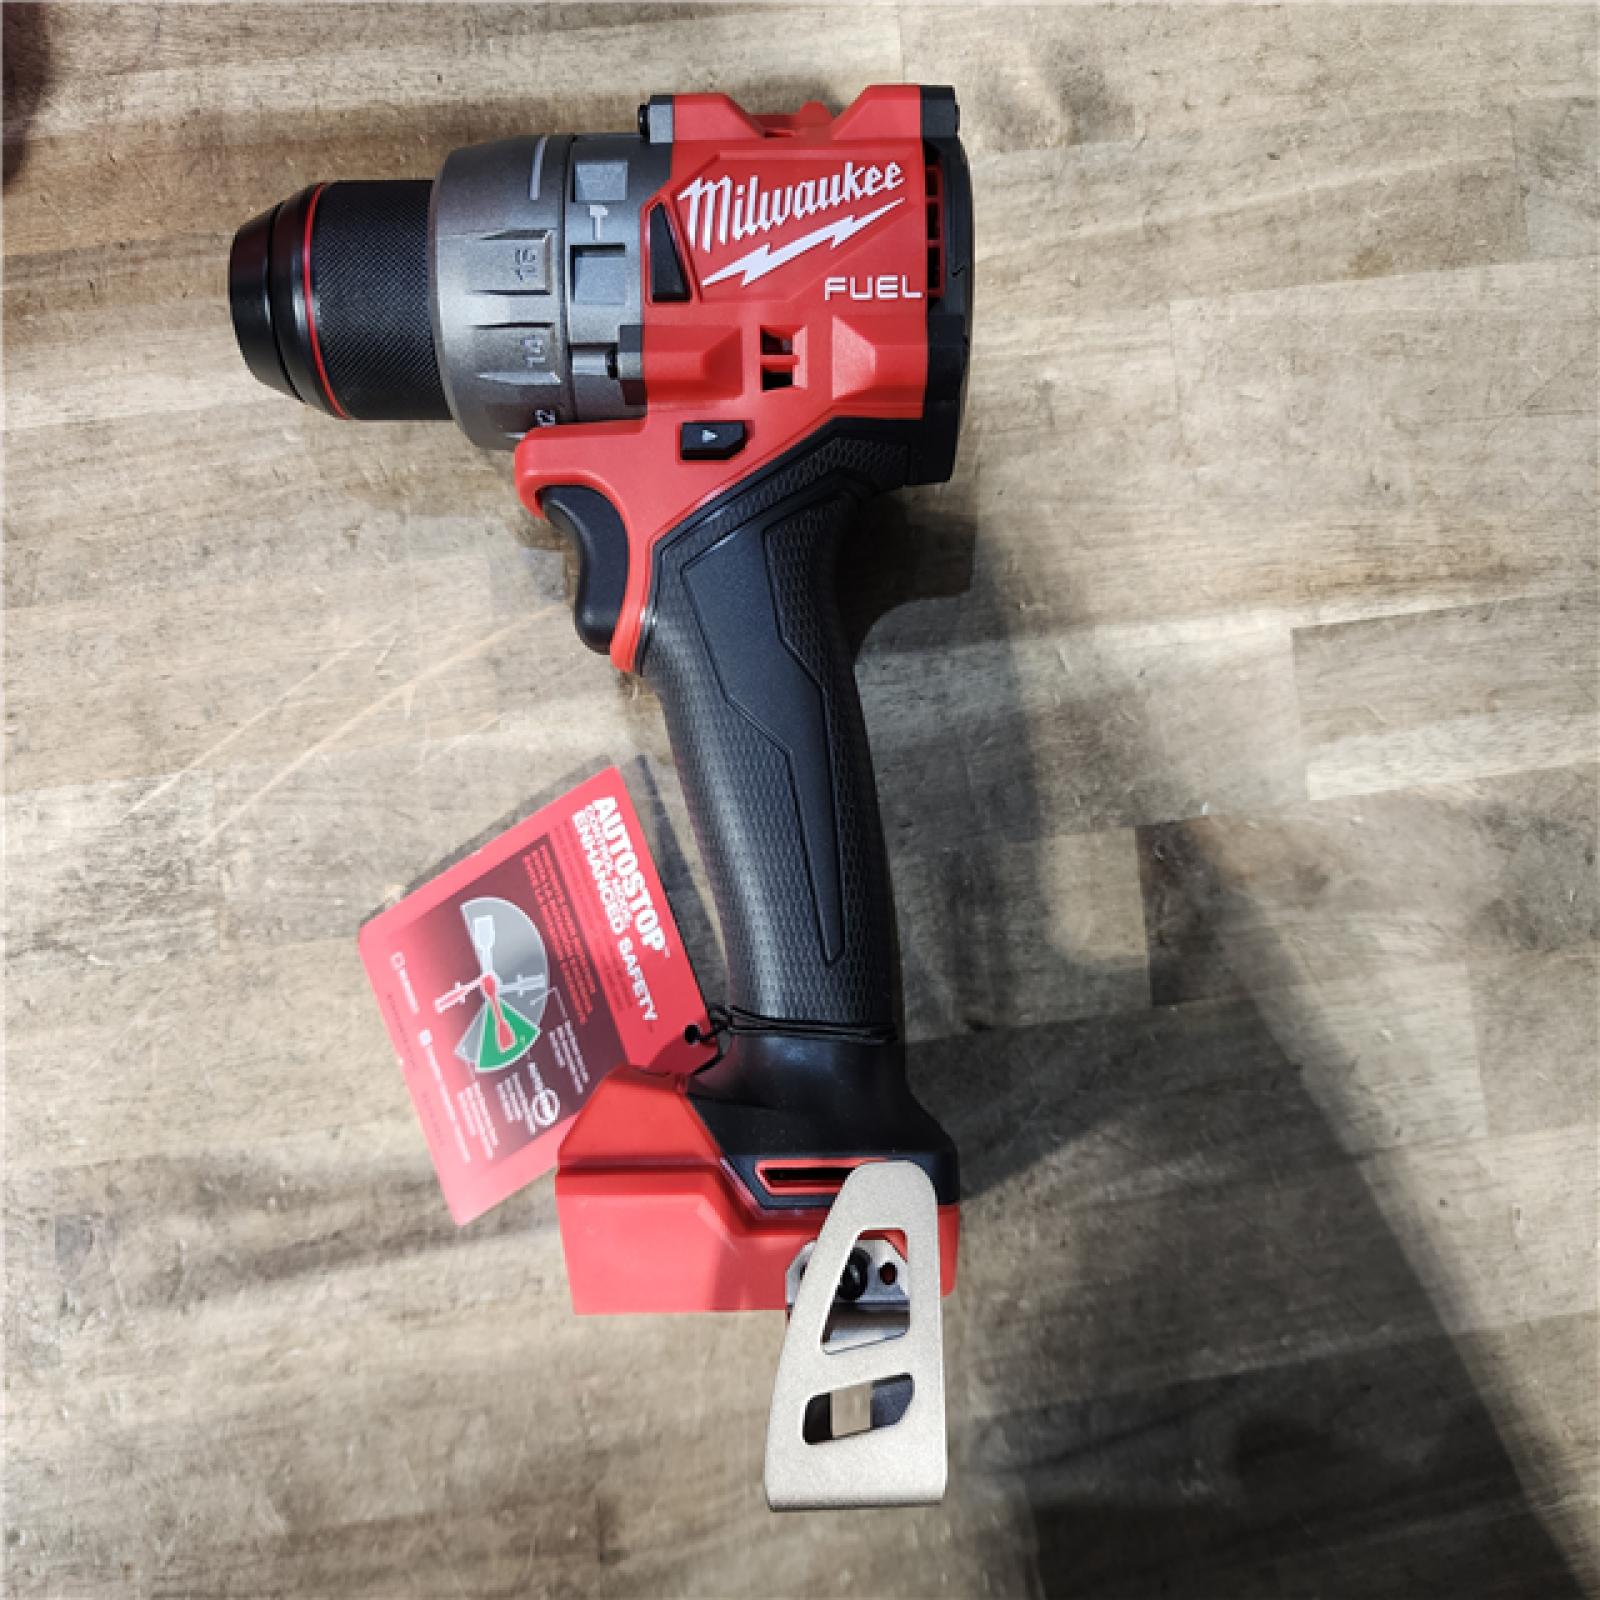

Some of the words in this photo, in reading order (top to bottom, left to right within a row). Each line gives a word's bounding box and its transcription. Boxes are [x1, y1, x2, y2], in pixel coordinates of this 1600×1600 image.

[677, 161, 904, 254] Milwaukee
[824, 275, 922, 301] FUEL
[572, 809, 625, 935] ENHANCED
[618, 936, 658, 1021] SAFETY
